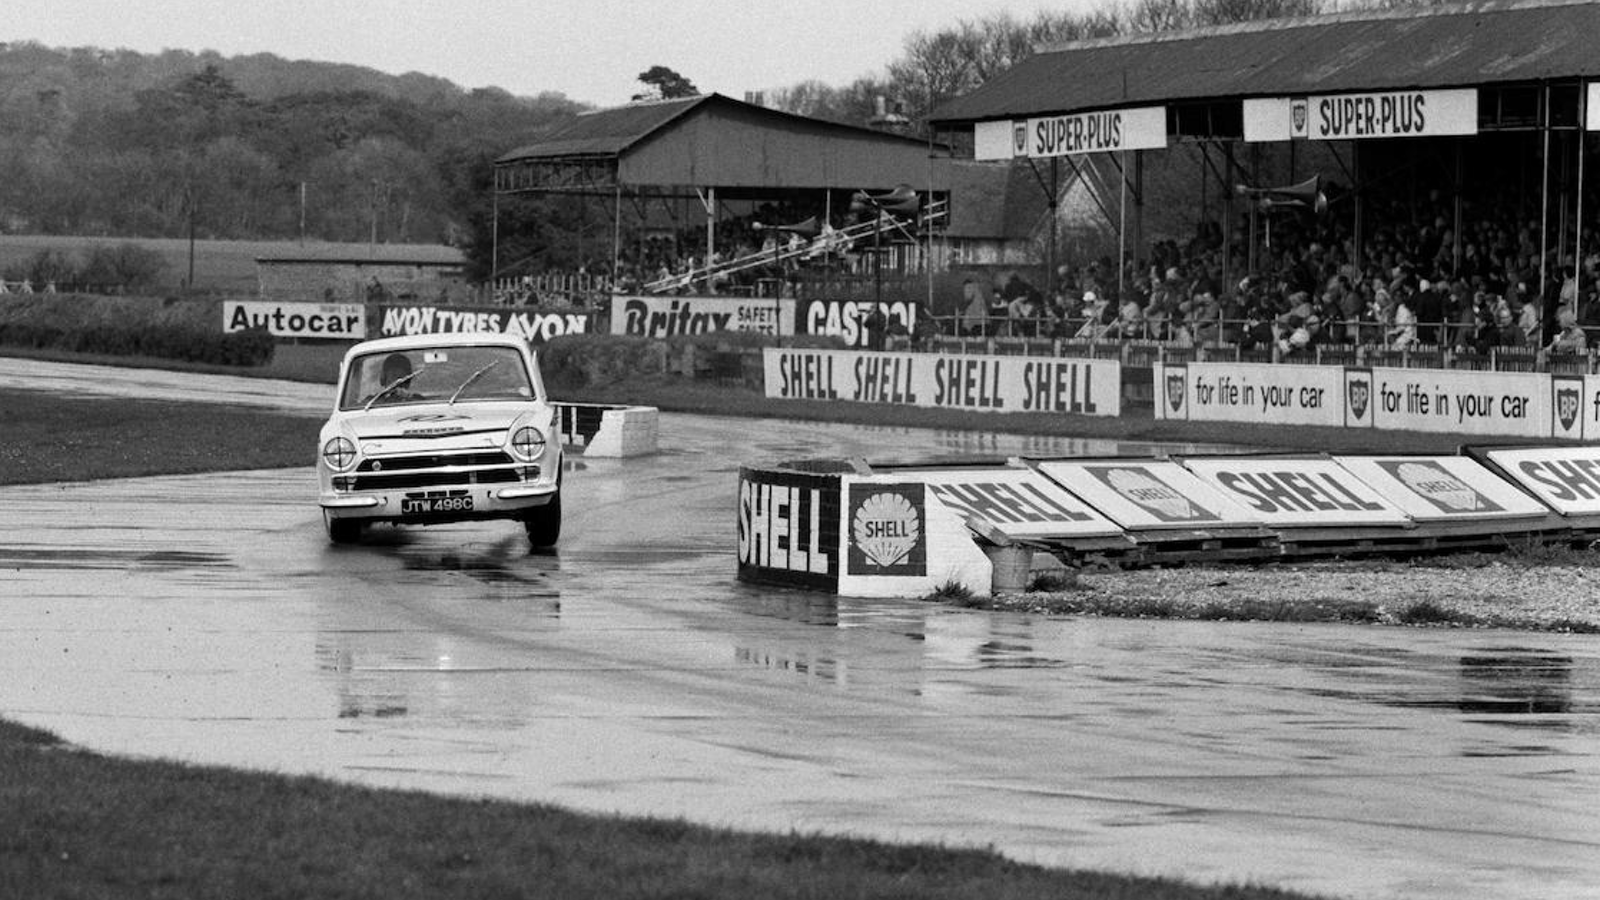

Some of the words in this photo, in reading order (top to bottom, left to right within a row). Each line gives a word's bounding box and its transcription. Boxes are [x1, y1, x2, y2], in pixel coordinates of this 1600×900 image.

[229, 305, 358, 333] Autocar
[381, 307, 436, 335] AVON
[436, 311, 500, 334] TYRES
[505, 313, 587, 341] AVON
[779, 354, 837, 399] SHELL
[854, 357, 915, 403] SHELL
[935, 358, 1003, 408] SHELL
[1023, 362, 1096, 413] SHELL
[1195, 376, 1214, 405] for
[1218, 377, 1238, 405] life
[1242, 377, 1254, 405] in
[1261, 385, 1293, 414] your
[1299, 385, 1325, 408] car
[1352, 387, 1367, 409] BP
[1380, 382, 1401, 412] for
[1406, 384, 1428, 414] life
[1434, 385, 1448, 415] in
[1456, 394, 1493, 424] your
[1500, 395, 1528, 418] car
[1561, 396, 1577, 419] BP
[1128, 487, 1180, 500] SHELL
[1217, 471, 1385, 513] SHELL
[1416, 480, 1467, 493] SHELL
[403, 500, 431, 513] JTW
[433, 498, 472, 511] 498C
[927, 483, 1094, 524] SHELL
[740, 479, 829, 574] SHELL
[865, 521, 909, 539] SHELL
